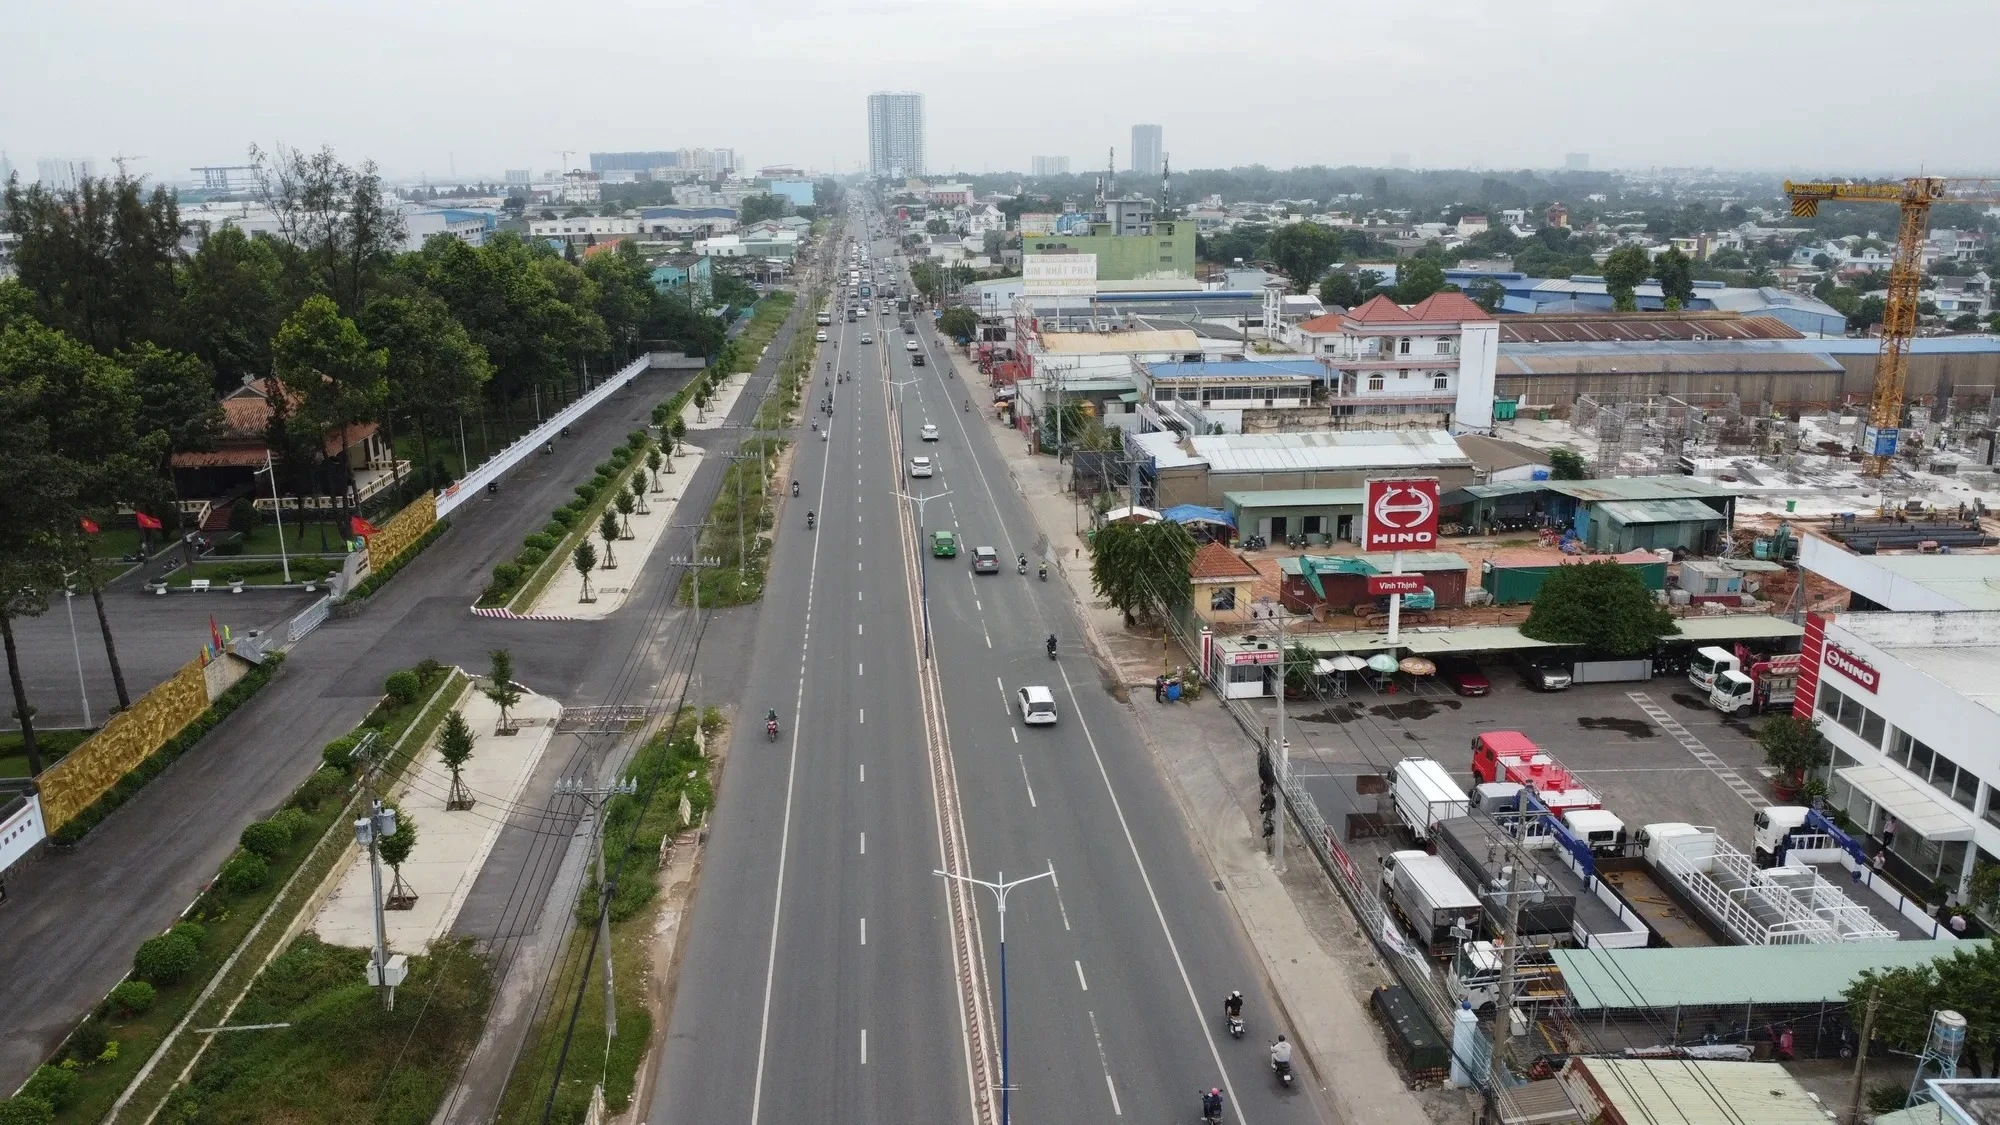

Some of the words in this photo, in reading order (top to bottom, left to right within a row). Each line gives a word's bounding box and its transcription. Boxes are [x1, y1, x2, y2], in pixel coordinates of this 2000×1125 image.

[1026, 266, 1041, 275] KIM
[1372, 532, 1432, 544] HINO
[1396, 581, 1418, 590] Thịnh
[1839, 658, 1874, 686] HINO
